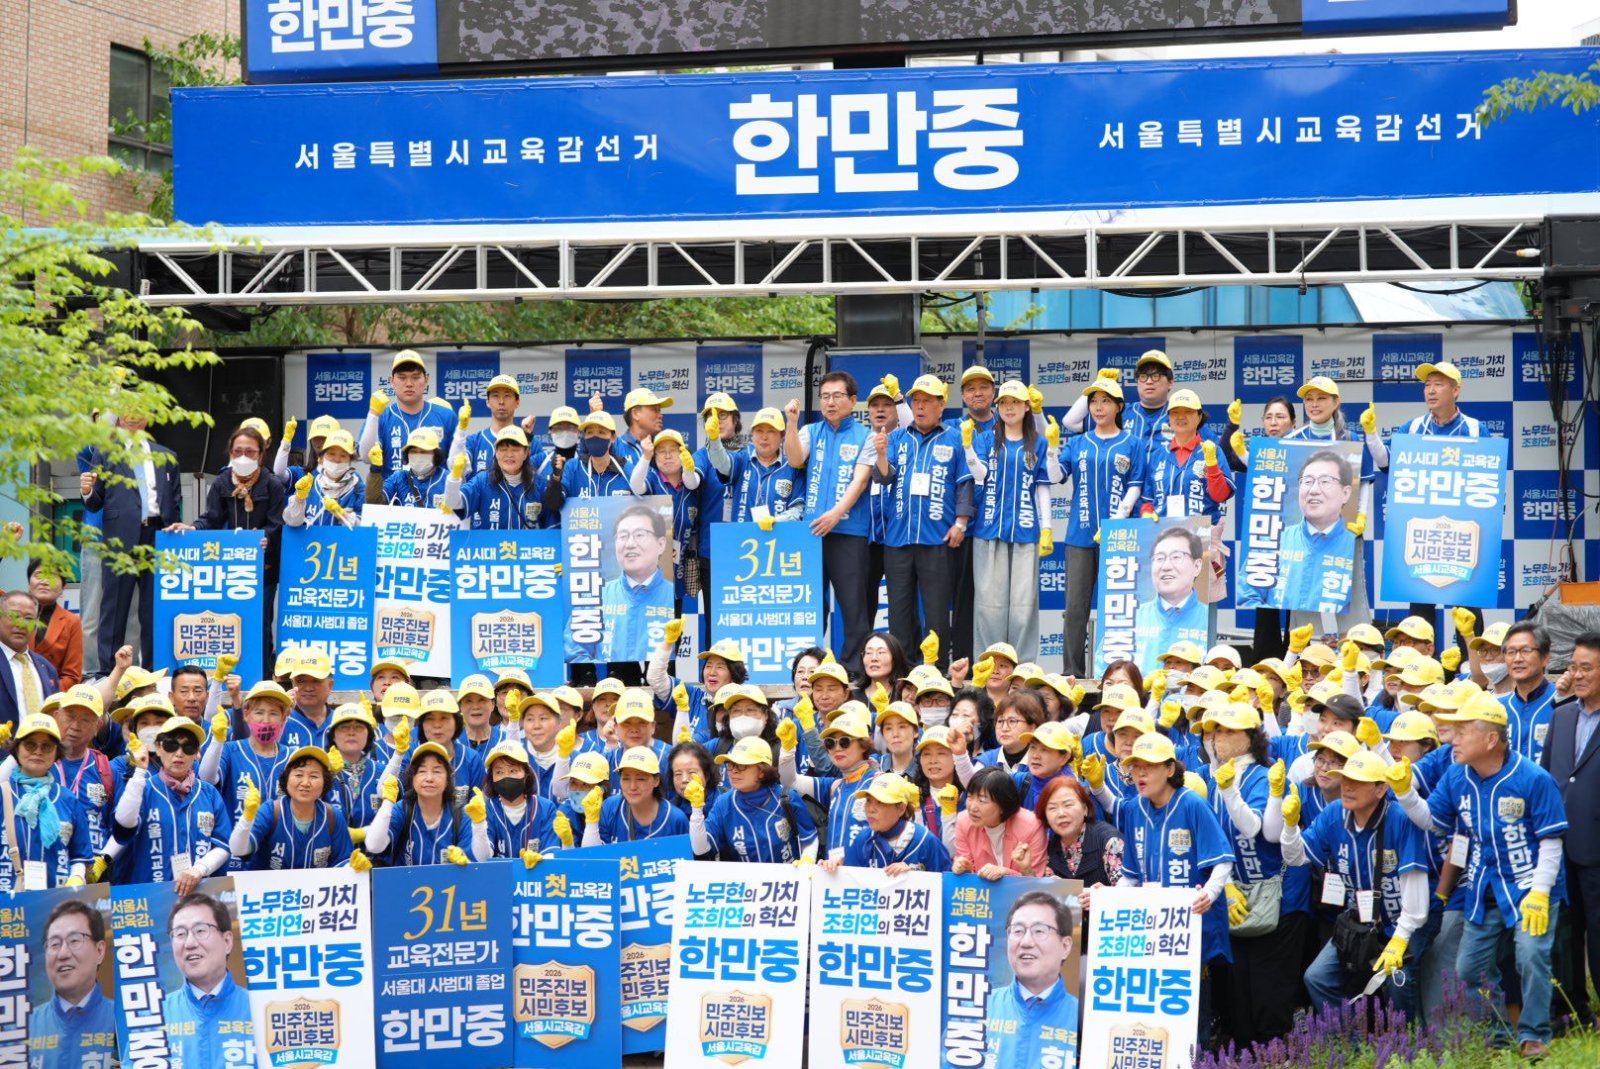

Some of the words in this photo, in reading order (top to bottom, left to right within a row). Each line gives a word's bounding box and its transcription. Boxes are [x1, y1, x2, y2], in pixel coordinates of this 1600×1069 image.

[267, 0, 416, 53] 한만중
[1098, 112, 1484, 151] 서울특별시교육감선거
[729, 88, 1024, 196] 한만중
[294, 134, 660, 171] 서울특별시교육감선거
[1173, 360, 1207, 371] 노무현의
[1207, 358, 1226, 370] 가치
[1242, 354, 1295, 364] 서울시교육감
[1346, 357, 1365, 367] 가치
[1381, 352, 1434, 363] 서울시교육감
[1485, 355, 1505, 366] 가치
[444, 369, 495, 379] 서울시교육감
[573, 366, 624, 377] 서울시교육감
[638, 369, 670, 380] 노무현의
[671, 368, 689, 379] 가치
[704, 363, 755, 374] 서울시교육감
[770, 368, 802, 379] 노무현의
[937, 363, 955, 374] 가치
[1038, 362, 1071, 373] 노무현의
[1071, 361, 1090, 371] 가치
[1242, 365, 1295, 386] 한만중
[1346, 368, 1365, 379] 혁신
[314, 371, 364, 382] 서울시교육감
[541, 371, 558, 382] 가치
[671, 380, 689, 391] 혁신
[704, 375, 755, 395] 한만중
[1037, 374, 1071, 385] 조희연의
[1072, 372, 1090, 383] 혁신
[1174, 372, 1207, 383] 조희연의
[1208, 370, 1227, 381] 혁신
[314, 383, 364, 402] 한만중
[541, 382, 558, 393] 혁신
[573, 378, 624, 398] 한만중
[1521, 425, 1556, 436] 노무현의
[1256, 447, 1287, 460] 서울시
[1396, 451, 1411, 464] AI
[1413, 452, 1439, 466] 시대
[1441, 446, 1460, 467] 첫
[1462, 454, 1500, 468] 교육감
[1254, 459, 1286, 472] 교육감
[928, 465, 949, 521] 한만중
[1078, 450, 1090, 521] 서울시교육감
[1394, 468, 1500, 508] 한만중
[1019, 471, 1034, 528] 한만중
[569, 507, 599, 518] 서울시
[569, 519, 599, 530] 교육감
[1246, 475, 1287, 588] 한만중
[1107, 528, 1138, 541] 서울시
[1413, 528, 1473, 547] 민주진보
[179, 547, 200, 561] 시대
[202, 541, 220, 561] 첫
[222, 548, 258, 561] 교육감
[456, 549, 470, 560] AI
[472, 548, 497, 560] 시대
[499, 541, 517, 560] 첫
[519, 547, 556, 560] 교육감
[1106, 541, 1138, 552] 교육감
[1411, 545, 1471, 563] 시민후보
[300, 541, 359, 584] 31년
[735, 538, 802, 582] 31년
[1413, 563, 1468, 578] 서울시교육감
[160, 565, 258, 601] 한만중
[455, 564, 557, 600] 한만중
[568, 533, 603, 645] 한만중
[287, 587, 365, 608] 교육전문가
[721, 584, 811, 605] 교육전문가
[717, 613, 753, 626] 서울대
[756, 613, 791, 626] 사범대
[792, 612, 817, 626] 졸업
[1103, 555, 1139, 665] 한만중
[282, 615, 313, 628] 서울대
[314, 616, 345, 630] 사범대
[347, 616, 368, 631] 졸업
[381, 617, 431, 635] 민주진보
[478, 622, 536, 640] 민주진보
[180, 625, 236, 640] 민주진보
[380, 632, 430, 648] 시민후보
[180, 640, 236, 656] 시민후보
[381, 646, 427, 660] 서울시교육감
[478, 639, 536, 655] 시민후보
[481, 656, 534, 670] 서울시교육감
[513, 881, 542, 898] 시대
[545, 873, 567, 899] 첫
[569, 881, 613, 899] 교육감
[685, 881, 757, 904] 노무현의
[759, 880, 799, 902] 가치
[951, 887, 990, 903] 서울시
[112, 898, 149, 914] 서울시
[240, 888, 315, 915] 노무현의
[317, 883, 358, 909] 가치
[822, 887, 891, 911] 노무현의
[893, 888, 930, 911] 가치
[403, 884, 488, 941] 31년
[684, 906, 756, 929] 조희연의
[759, 905, 799, 928] 혁신
[950, 902, 990, 918] 교육감
[1098, 909, 1156, 932] 노무현의
[1158, 906, 1191, 931] 가치
[112, 913, 149, 929] 교육감
[241, 913, 315, 940] 조희연의
[318, 908, 358, 932] 혁신
[822, 913, 890, 935] 조희연의
[893, 913, 930, 936] 혁신
[1097, 934, 1156, 958] 조희연의
[1158, 932, 1191, 956] 혁신
[387, 940, 499, 969] 교육전문가
[626, 951, 645, 960] 2026
[679, 936, 799, 983] 한만중
[244, 942, 364, 991] 한만중
[544, 969, 562, 977] 2026
[817, 942, 934, 993] 한만중
[381, 977, 425, 996] 서울대
[428, 975, 473, 994] 사범대
[475, 973, 505, 991] 졸업
[520, 978, 587, 997] 민주진보
[1092, 965, 1192, 1016] 한만중
[945, 921, 992, 1068] 한만중
[294, 1003, 311, 1011] 2026
[520, 997, 587, 1018] 시민후보
[706, 1003, 766, 1022] 민주진보
[867, 1003, 882, 1011] 2026
[271, 1011, 335, 1030] 민주진보
[381, 1004, 506, 1053] 한만중
[523, 1019, 586, 1037] 서울시교육감
[846, 1010, 903, 1030] 민주진보
[271, 1028, 335, 1047] 시민후보
[705, 1021, 765, 1039] 시민후보
[845, 1028, 903, 1048] 시민후보
[706, 1040, 763, 1056] 서울시교육감
[1112, 1036, 1163, 1056] 민주진보
[275, 1047, 334, 1064] 서울시교육감
[847, 1049, 901, 1065] 서울시교육감
